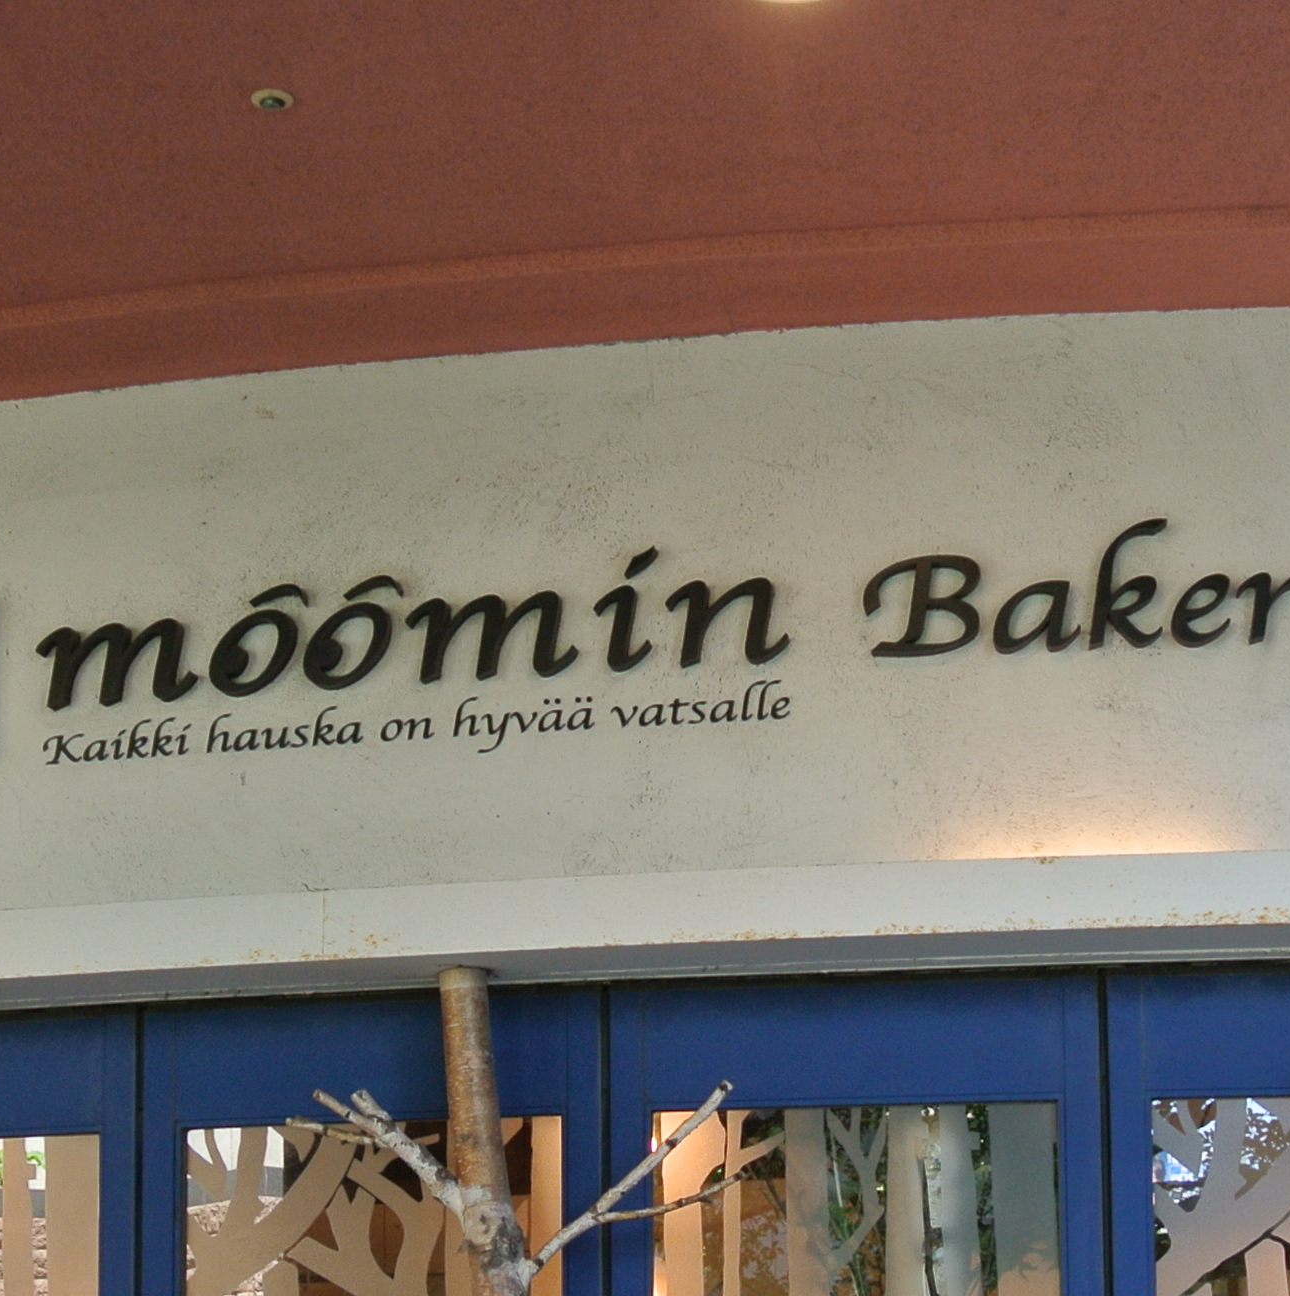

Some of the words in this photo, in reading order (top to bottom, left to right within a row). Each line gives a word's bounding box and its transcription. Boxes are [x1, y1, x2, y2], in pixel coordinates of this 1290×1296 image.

[42, 717, 192, 766] Kaikki
[206, 705, 364, 754] hauska
[380, 717, 435, 742] on
[452, 696, 596, 754] hyvää
[610, 679, 791, 728] vatsalle
